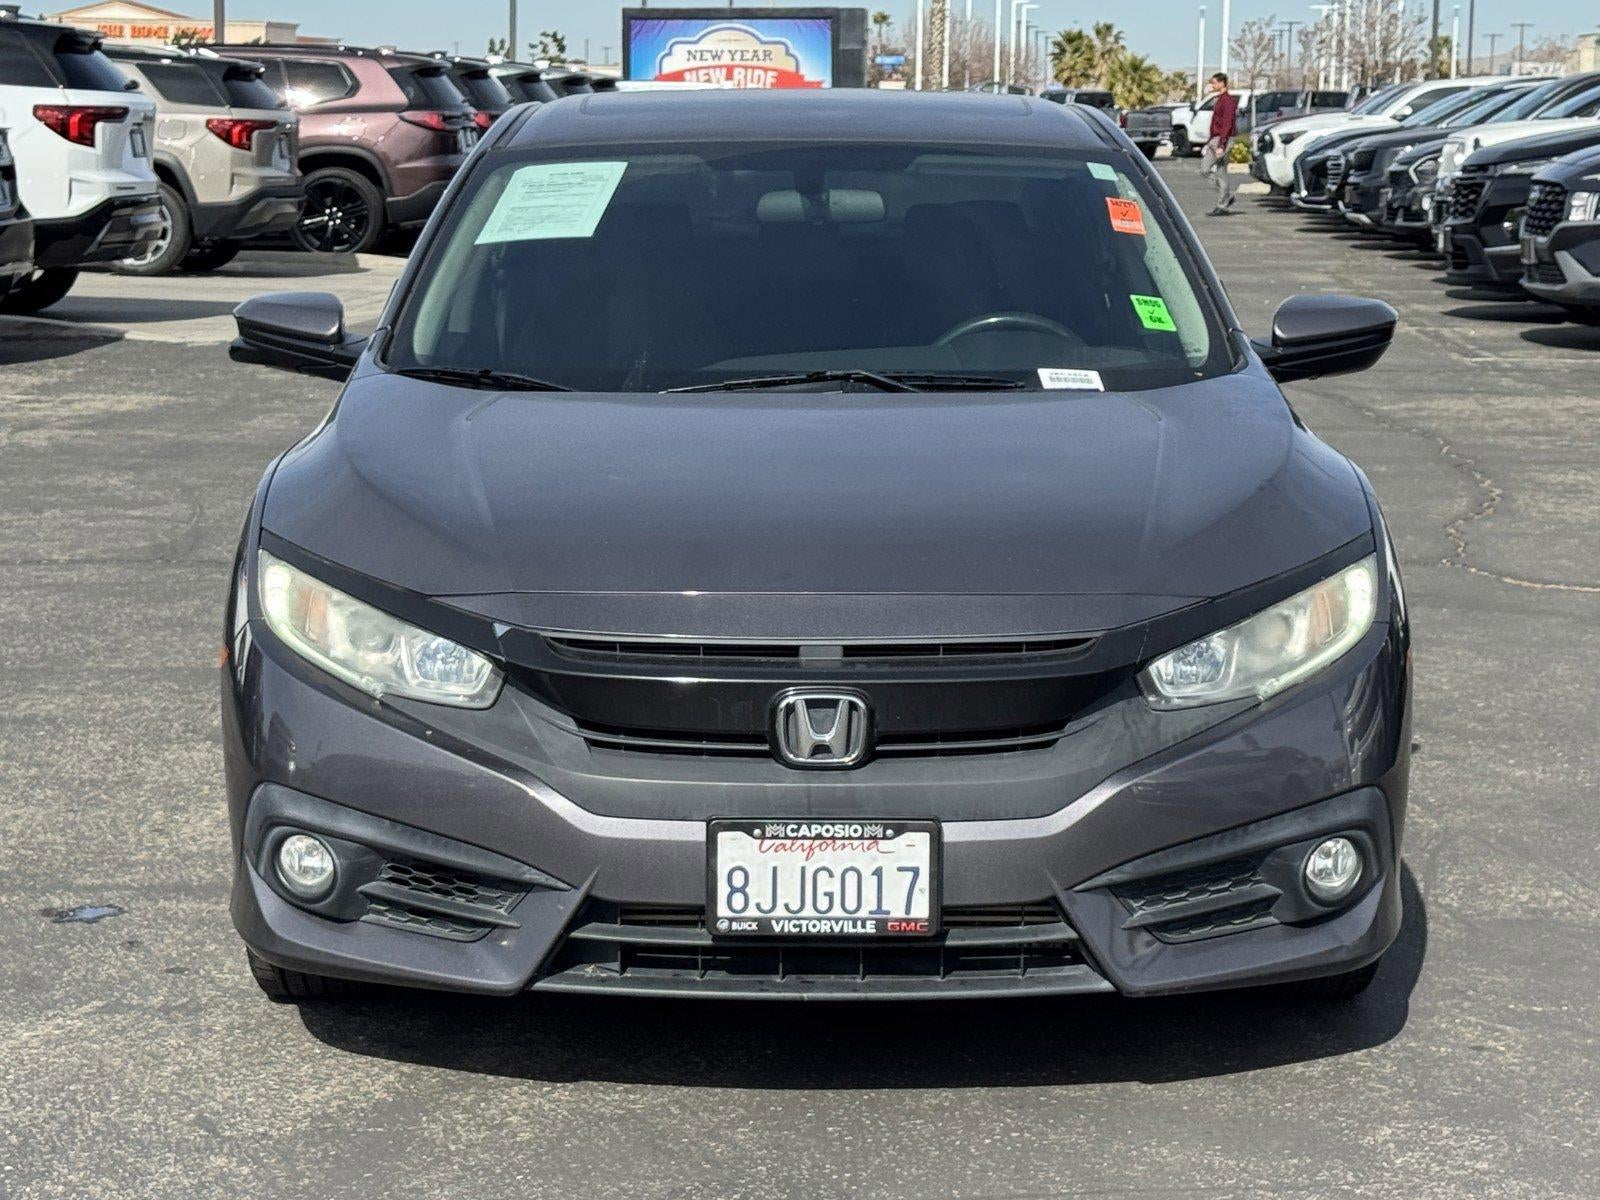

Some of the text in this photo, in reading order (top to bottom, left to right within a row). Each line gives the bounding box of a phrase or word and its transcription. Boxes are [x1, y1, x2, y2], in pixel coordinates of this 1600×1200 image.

[687, 49, 774, 62] NEW YEAR
[785, 824, 863, 838] CAPOSIO
[758, 838, 895, 862] California
[726, 865, 920, 916] 8JJG017
[731, 921, 759, 931] BUICK
[770, 919, 877, 933] VICTORVILLE
[886, 921, 929, 932] GMC
